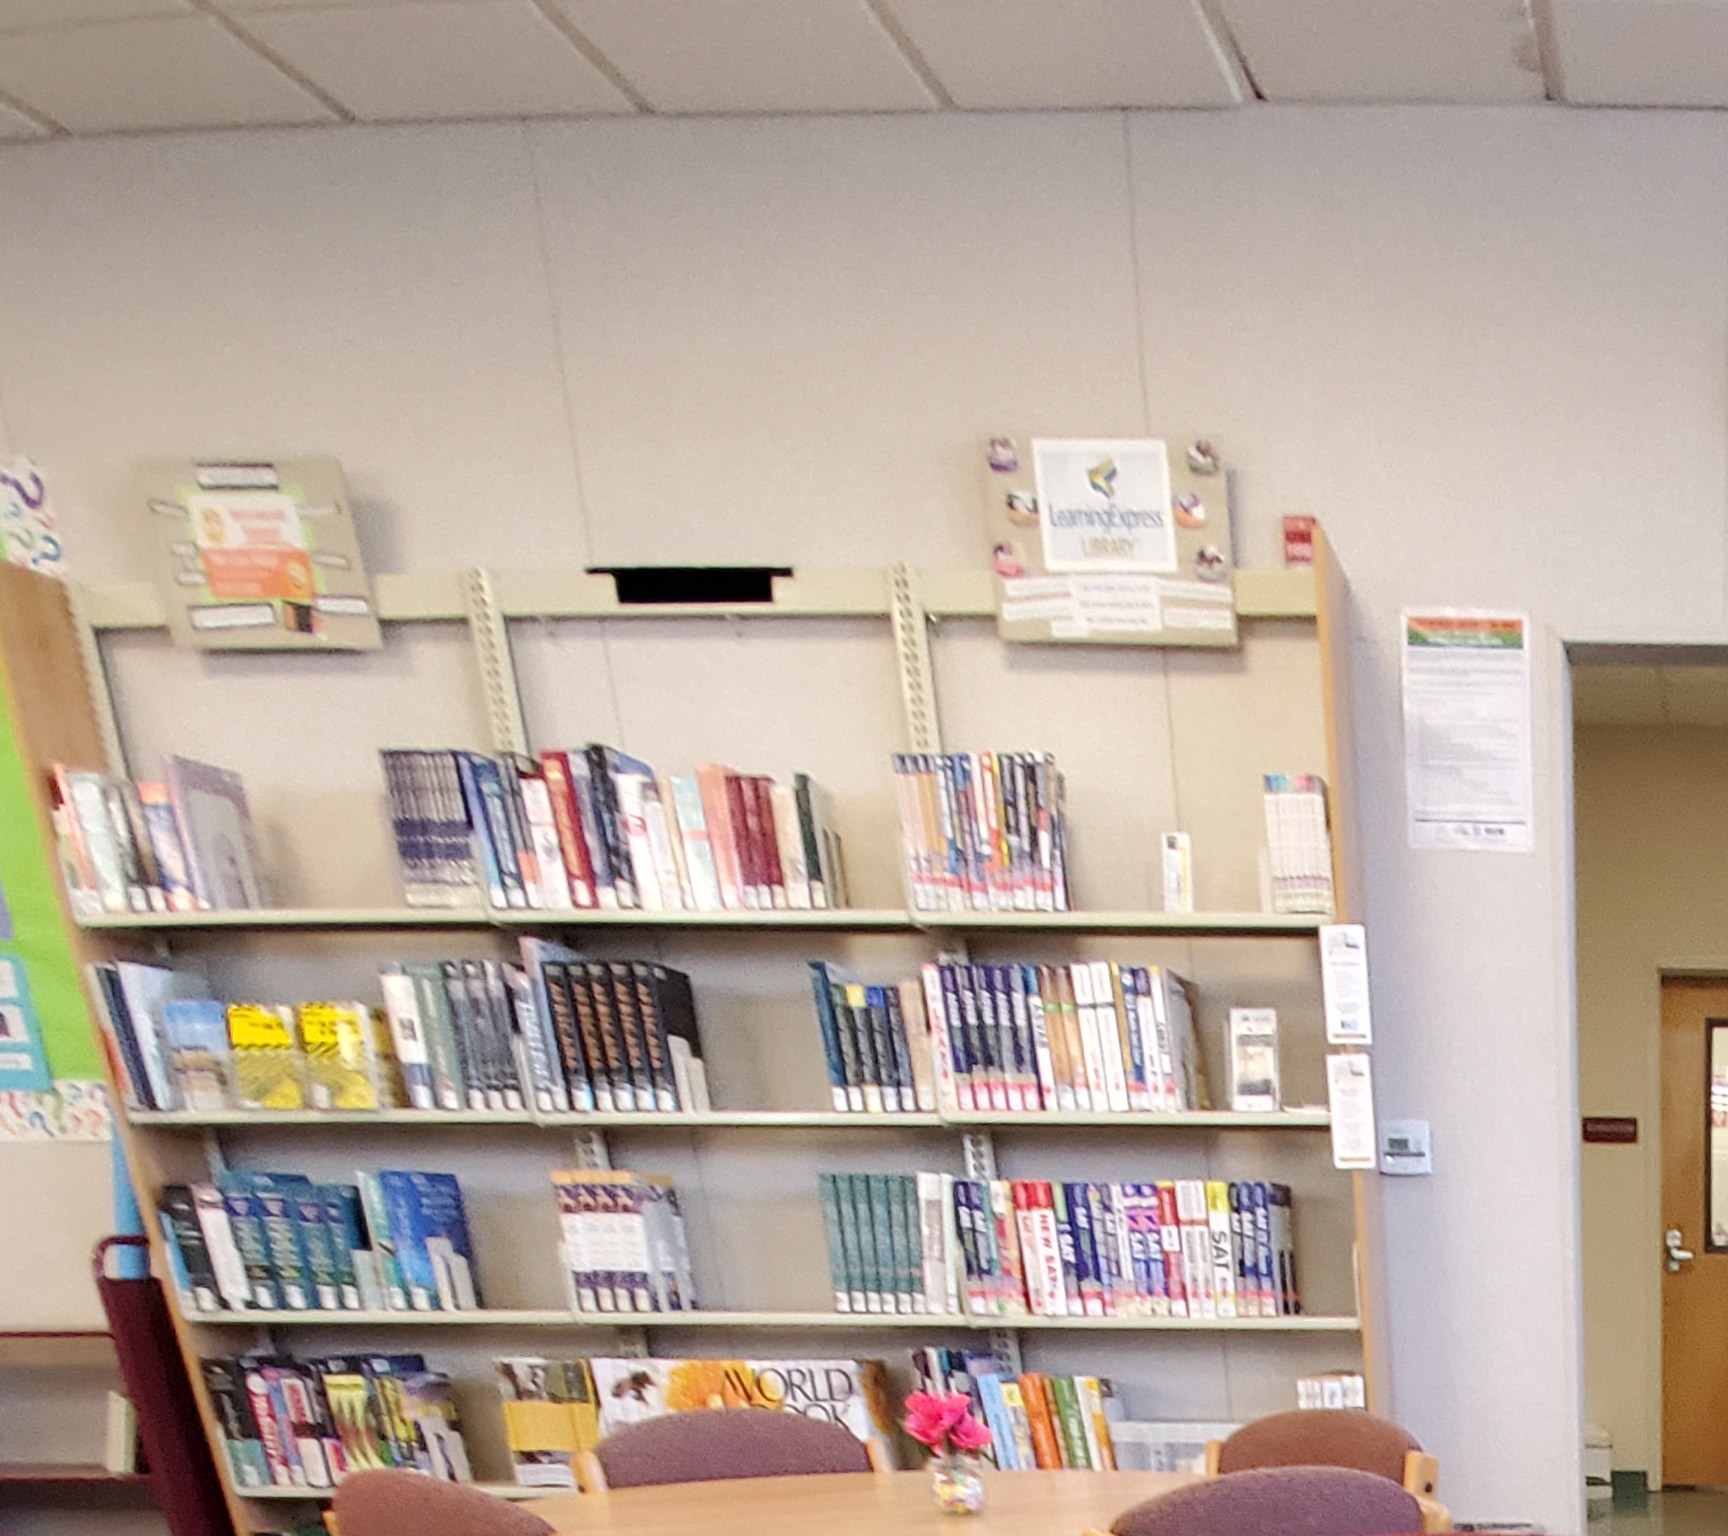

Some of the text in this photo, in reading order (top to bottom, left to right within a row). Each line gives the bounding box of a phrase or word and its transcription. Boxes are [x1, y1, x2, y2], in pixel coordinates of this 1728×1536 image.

[1048, 503, 1164, 532] LearningExpress
[1080, 536, 1138, 558] LIBRARY
[723, 1366, 854, 1404] WORLD
